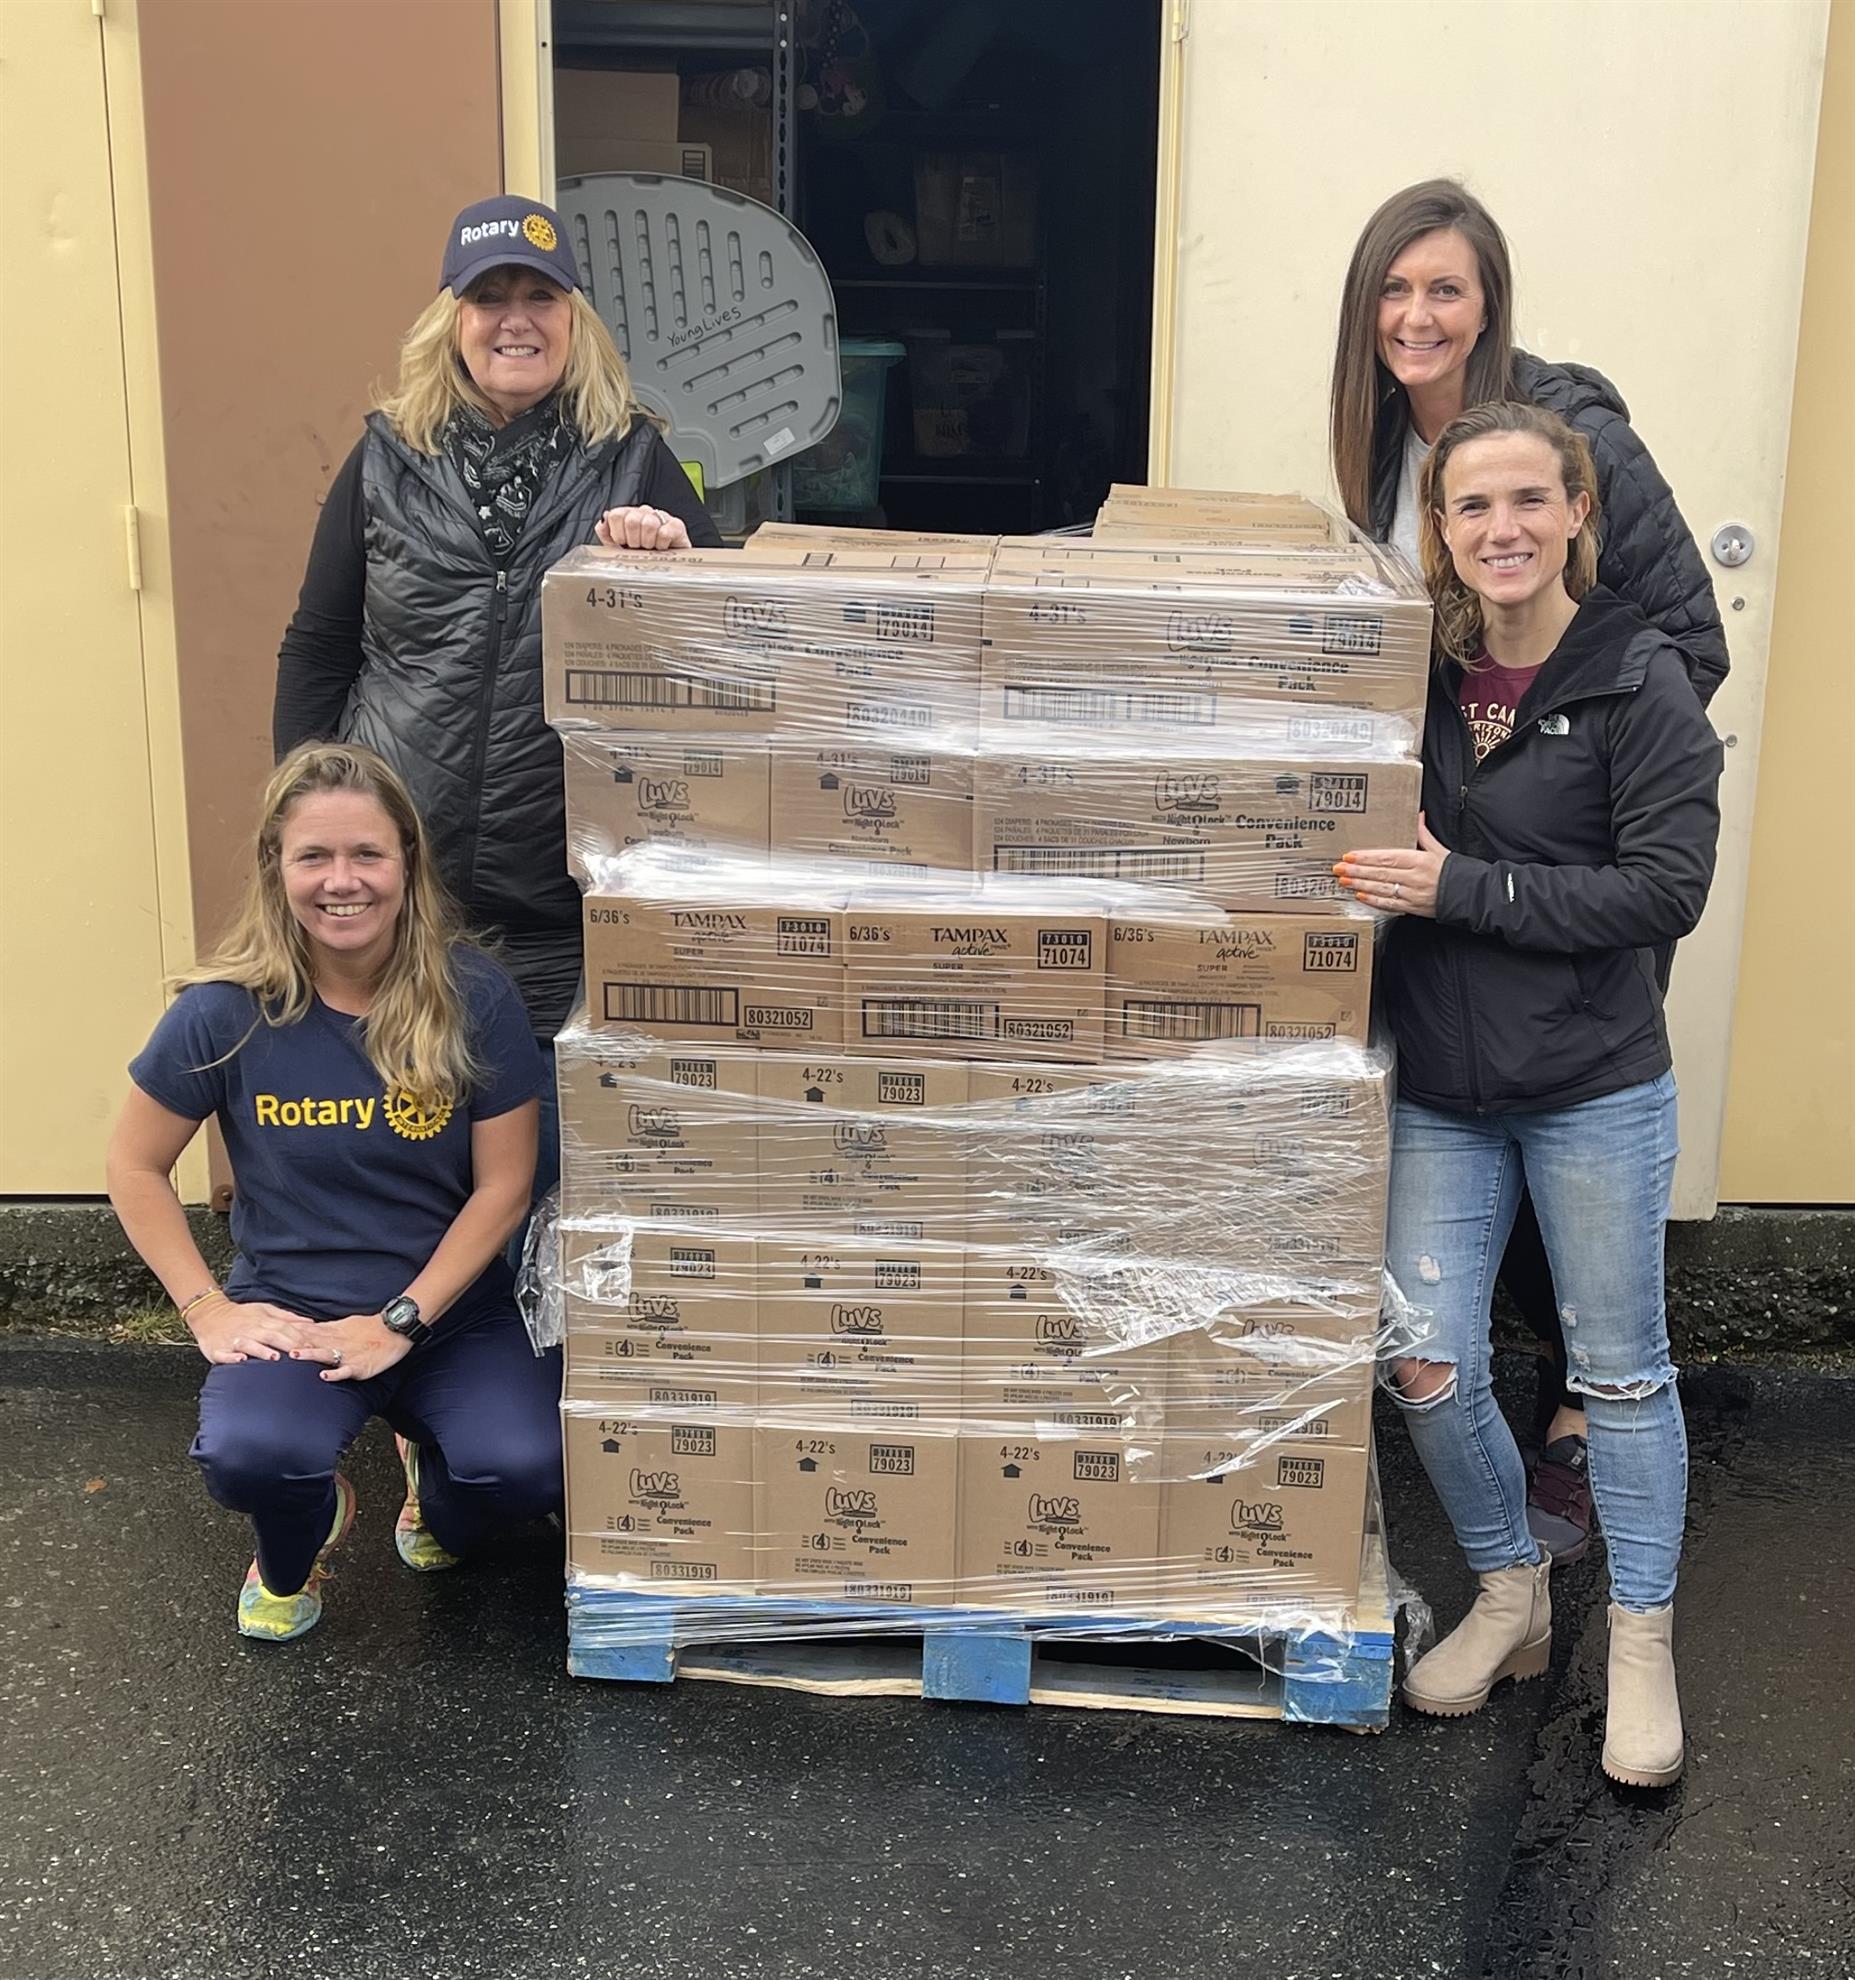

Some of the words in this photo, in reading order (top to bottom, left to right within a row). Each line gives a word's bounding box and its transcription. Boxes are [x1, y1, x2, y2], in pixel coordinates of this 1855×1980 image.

[461, 219, 519, 246] Rotary
[586, 587, 643, 609] 4-31's
[881, 620, 928, 638] 79014
[638, 777, 690, 810] Luvs
[843, 784, 896, 817] Luvs
[1314, 790, 1361, 808] 79014
[1235, 814, 1336, 831] Convenience
[1162, 836, 1211, 846] Newborn
[1265, 834, 1303, 848] Pack
[590, 909, 630, 925] 6/36's
[670, 912, 747, 930] TAMPAX
[850, 926, 890, 941] 6/36's
[930, 928, 1008, 943] TAMPAX
[1113, 928, 1154, 942] 6/36's
[1196, 930, 1273, 945] TAMPAX
[782, 935, 825, 953] 71074
[952, 943, 996, 959] active
[1043, 948, 1086, 966] 71074
[1216, 945, 1260, 961] active
[1309, 950, 1352, 968] 71074
[1197, 964, 1228, 972] SUPER
[748, 1009, 810, 1027] 80321052
[1007, 1022, 1070, 1039] 80321052
[1269, 1023, 1332, 1041] 80321052
[675, 1072, 713, 1087] 79023
[802, 1067, 844, 1083] 4-22's
[1012, 1078, 1054, 1094] 4-22's
[882, 1087, 920, 1101] 79023
[254, 1094, 376, 1130] Rotary
[800, 1254, 841, 1269] 4-22's
[878, 1273, 917, 1287] 79023
[1006, 1266, 1048, 1281] 4-22's
[831, 1304, 884, 1335] Luvs
[656, 1341, 711, 1352] Convenience
[673, 1352, 694, 1360] Pack
[858, 1353, 914, 1365] Convenience
[599, 1421, 638, 1435] 4-22's
[1264, 1420, 1323, 1436] 803919
[675, 1439, 712, 1453] 79023
[795, 1440, 836, 1454] 4-22's
[1000, 1446, 1040, 1460] 4-22's
[873, 1457, 910, 1471] 79023
[1077, 1464, 1115, 1478] 79023
[629, 1468, 681, 1499] Luvs
[1282, 1470, 1319, 1485] 79023
[825, 1487, 877, 1517] Luvs
[1028, 1493, 1080, 1524] Luvs
[657, 1516, 711, 1527] Convenience
[1231, 1499, 1283, 1530] Luvs
[674, 1527, 695, 1535] Pack
[852, 1535, 908, 1546] Convenience
[1055, 1541, 1111, 1552] Convenience
[869, 1546, 890, 1554] Pack
[1071, 1552, 1093, 1561] Pack
[1256, 1548, 1313, 1559] Convenience
[1273, 1559, 1295, 1567] Pack
[655, 1564, 712, 1579] 80331919
